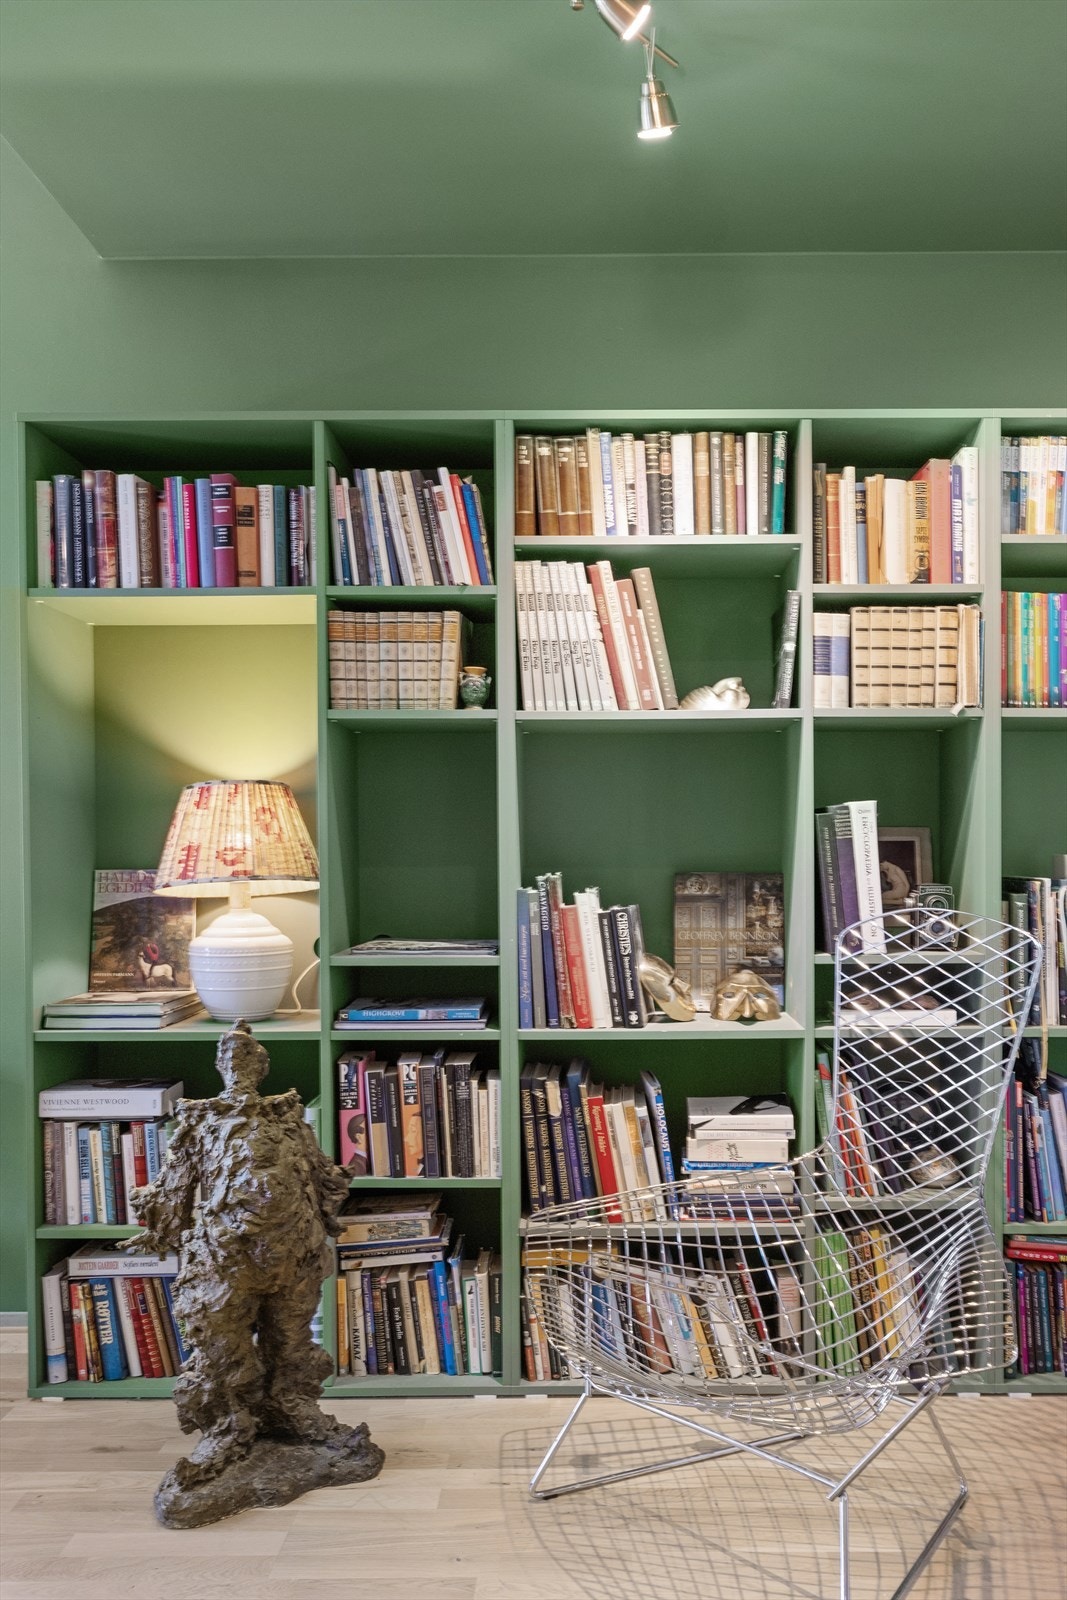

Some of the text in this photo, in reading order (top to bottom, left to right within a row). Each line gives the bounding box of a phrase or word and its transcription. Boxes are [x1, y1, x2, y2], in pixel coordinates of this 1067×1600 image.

[602, 453, 612, 482] JERSILD
[915, 482, 928, 520] DAN BROWN
[952, 499, 963, 552] MAX MANUS
[861, 816, 878, 937] ENCYCLOPAEDIA ILLUSTRAON
[539, 882, 549, 931] CARAVAGGIO
[679, 930, 779, 942] GEOFFREY BENNISON
[370, 1079, 378, 1118] Wodehouse
[522, 1089, 539, 1199] JANSON VERDENS KUNSTHISTORIE
[540, 1119, 549, 1147] VERDENS
[563, 1093, 571, 1116] CLASSIC
[569, 1142, 577, 1160] PLANS
[575, 1107, 591, 1178] SAINT PETERSBURG
[656, 1103, 670, 1153] HOLOCAUST
[80, 1159, 90, 1181] SELLER
[81, 1147, 89, 1158] GUN
[542, 1149, 554, 1197] KUNSTHISTORIE
[553, 1122, 569, 1200] VERDENS KUNSTHISTORIE
[732, 1278, 745, 1303] WILLIM
[97, 1300, 113, 1345] RØTTER
[396, 1322, 404, 1340] Berlin
[352, 1328, 361, 1360] KAVKAZ
